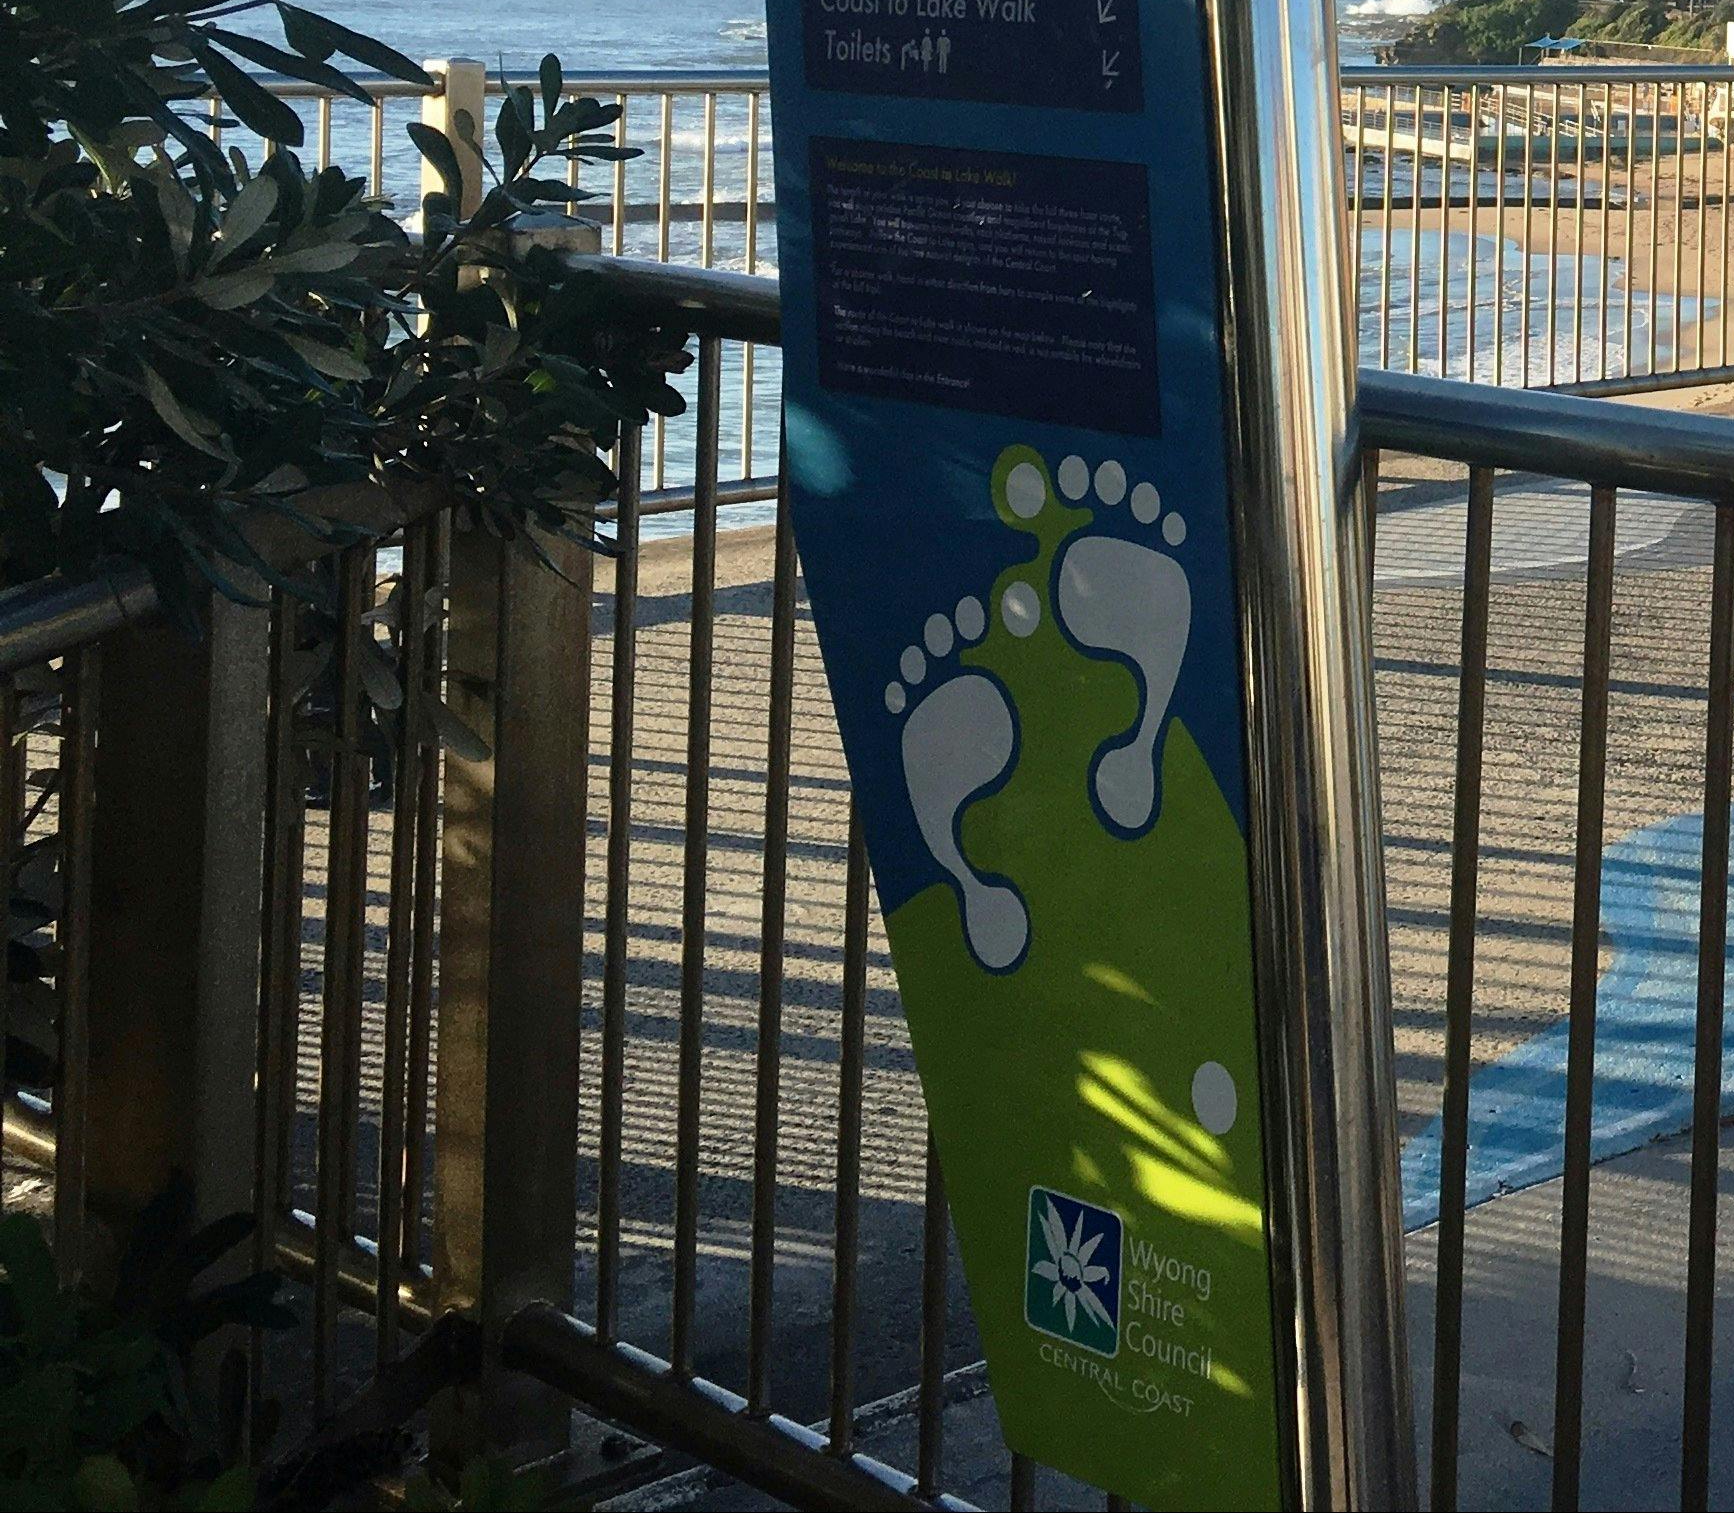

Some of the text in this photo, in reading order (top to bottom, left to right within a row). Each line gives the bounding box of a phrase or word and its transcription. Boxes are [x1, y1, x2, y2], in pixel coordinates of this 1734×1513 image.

[825, 29, 892, 65] Toilets
[1129, 1236, 1211, 1301] Wyong
[1127, 1279, 1185, 1327] Shire
[1126, 1321, 1212, 1380] Council
[1039, 1344, 1194, 1417] CENTRAL COAST
